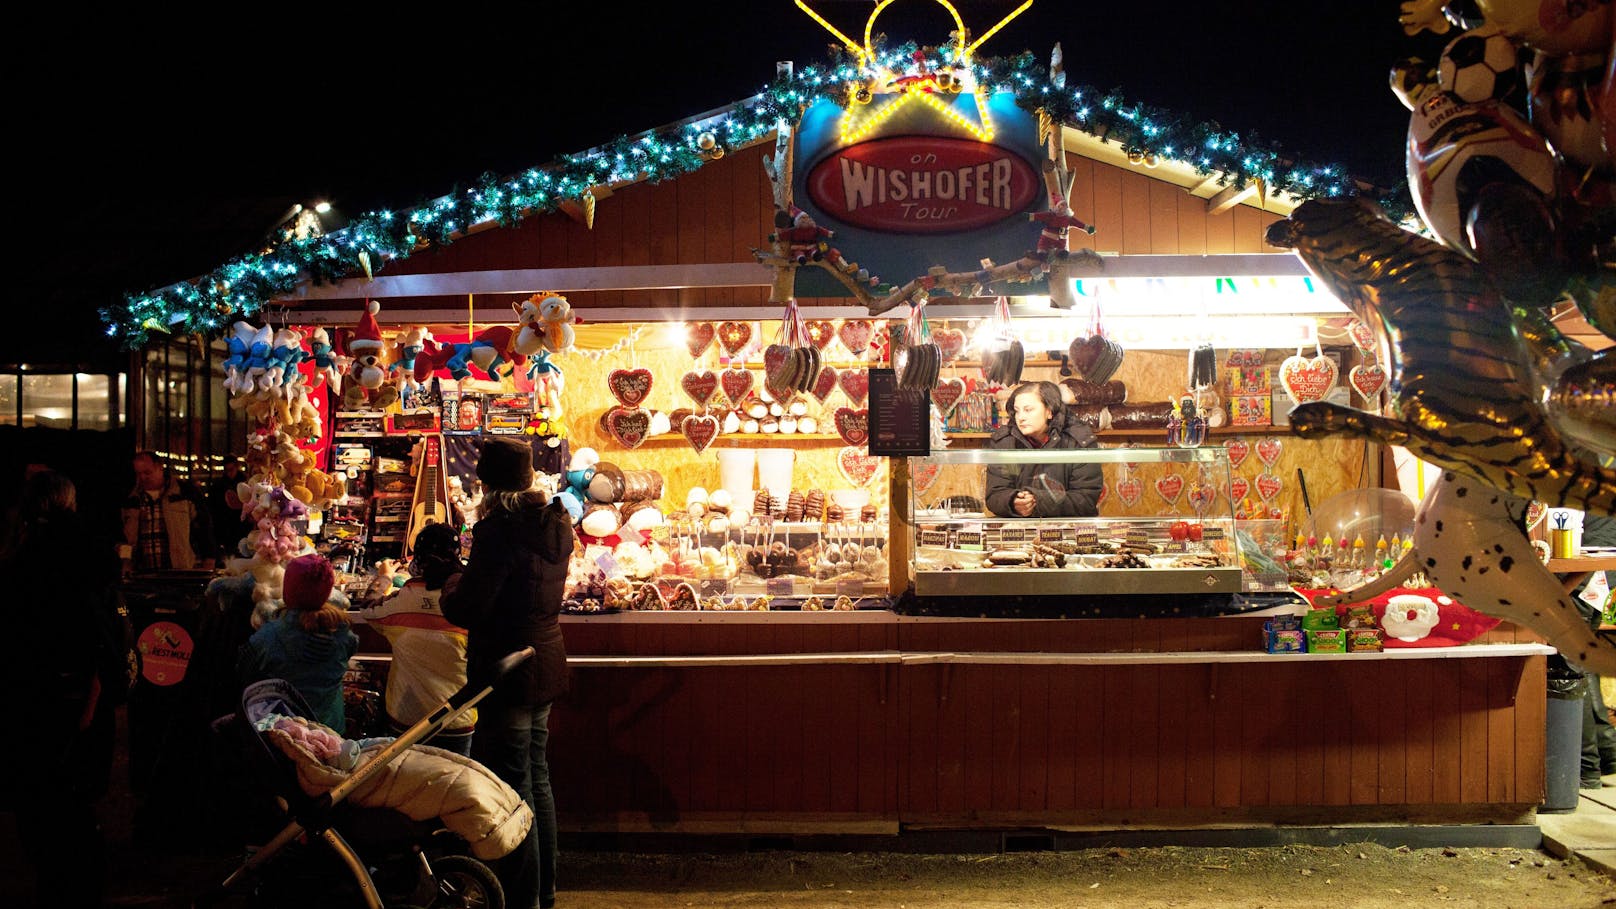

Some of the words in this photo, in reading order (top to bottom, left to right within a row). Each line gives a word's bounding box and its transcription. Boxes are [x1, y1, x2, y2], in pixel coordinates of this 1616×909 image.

[910, 152, 937, 165] on
[839, 157, 1013, 212] WISHOFER
[899, 202, 958, 220] Tour
